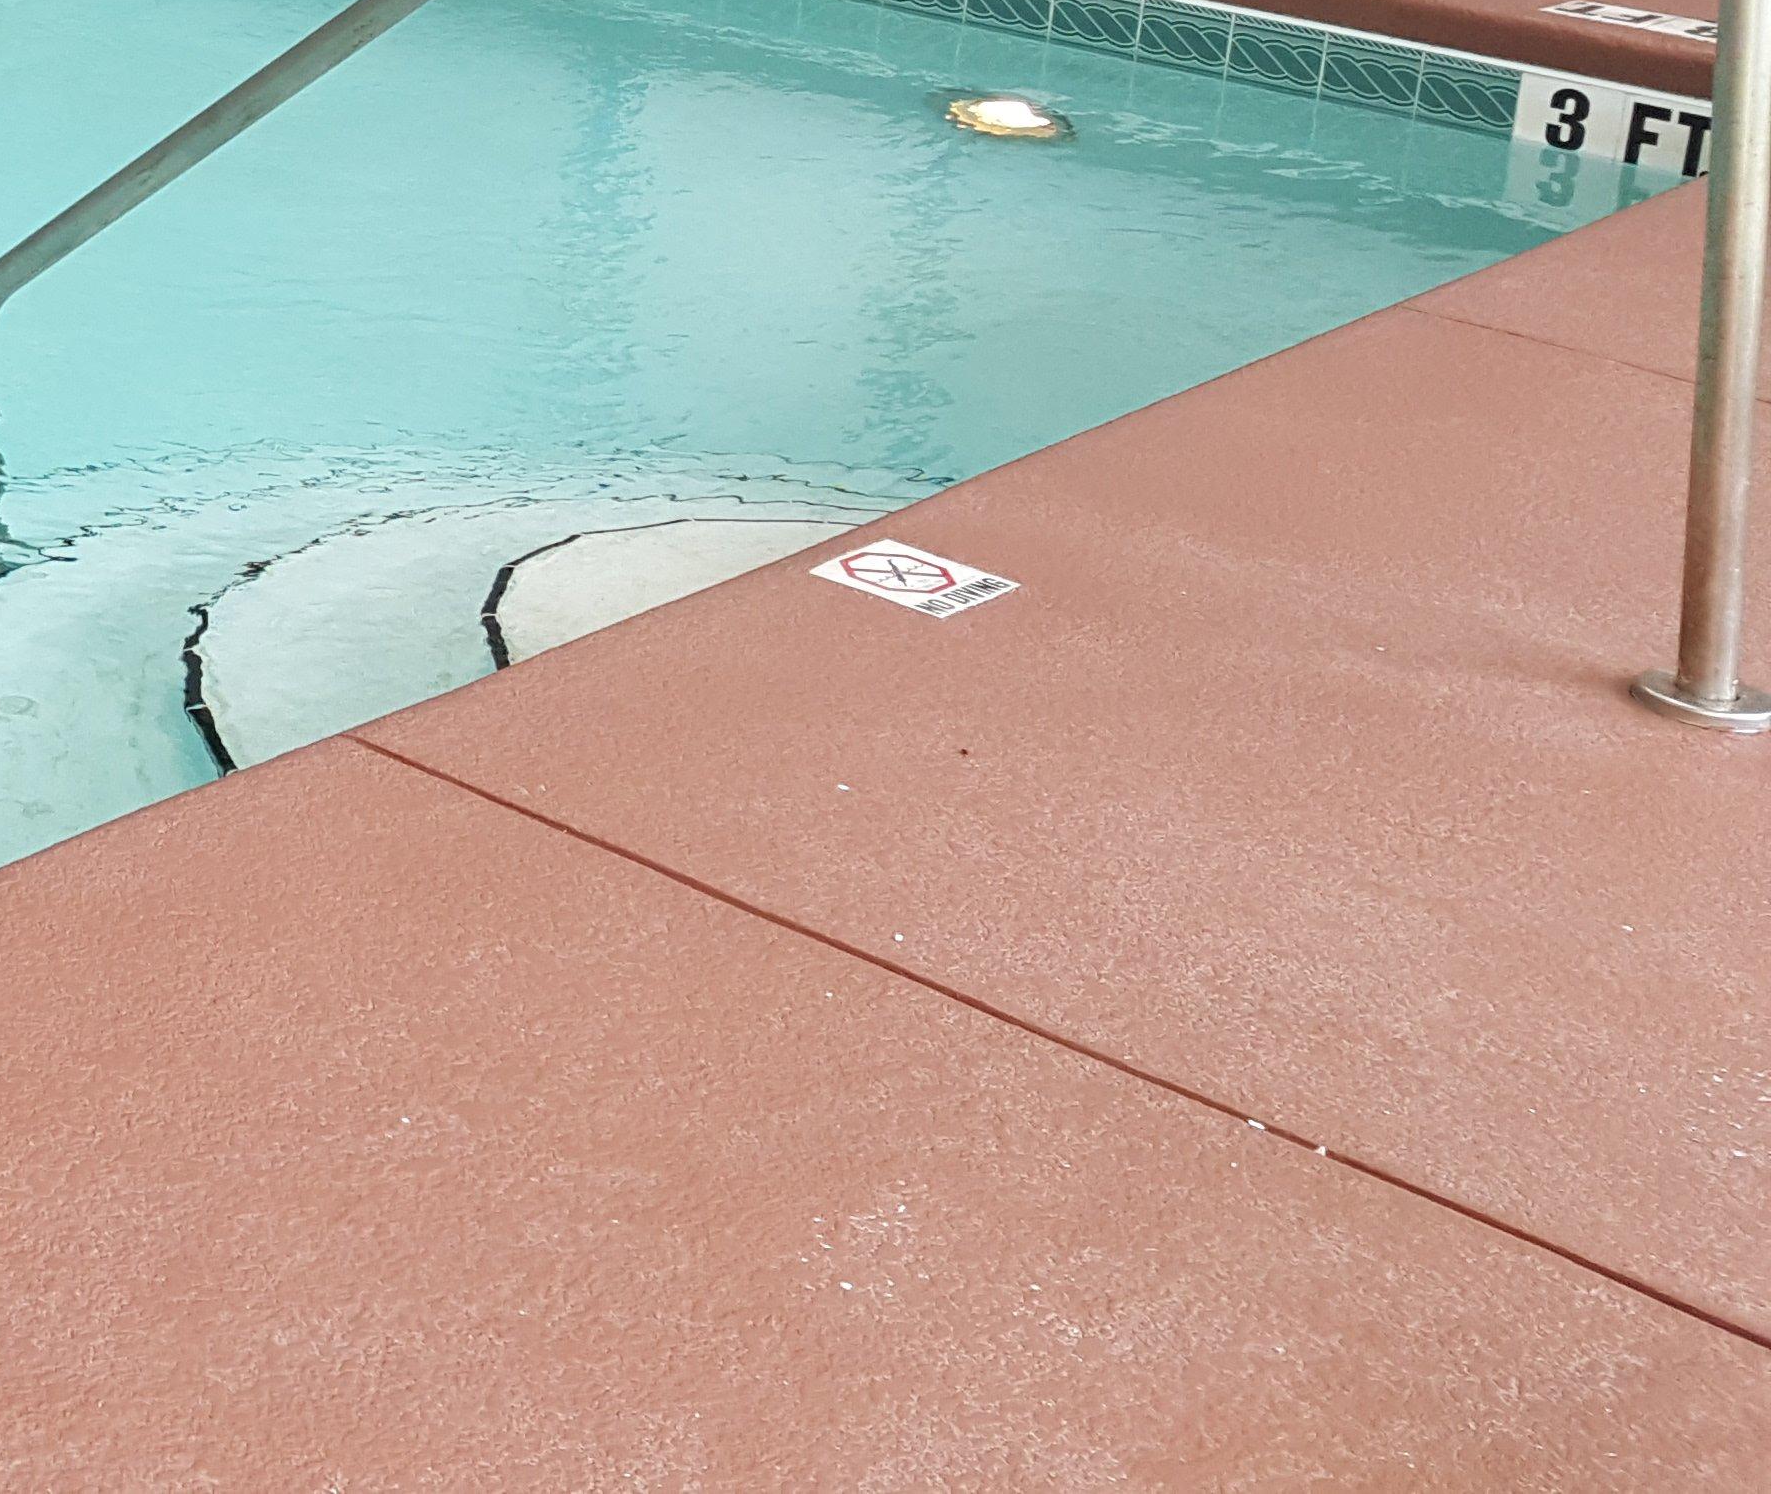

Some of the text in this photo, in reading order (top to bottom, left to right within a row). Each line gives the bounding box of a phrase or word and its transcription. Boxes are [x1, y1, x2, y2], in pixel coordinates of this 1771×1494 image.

[1545, 88, 1591, 151] 3
[914, 577, 1011, 615] NO DIVING
